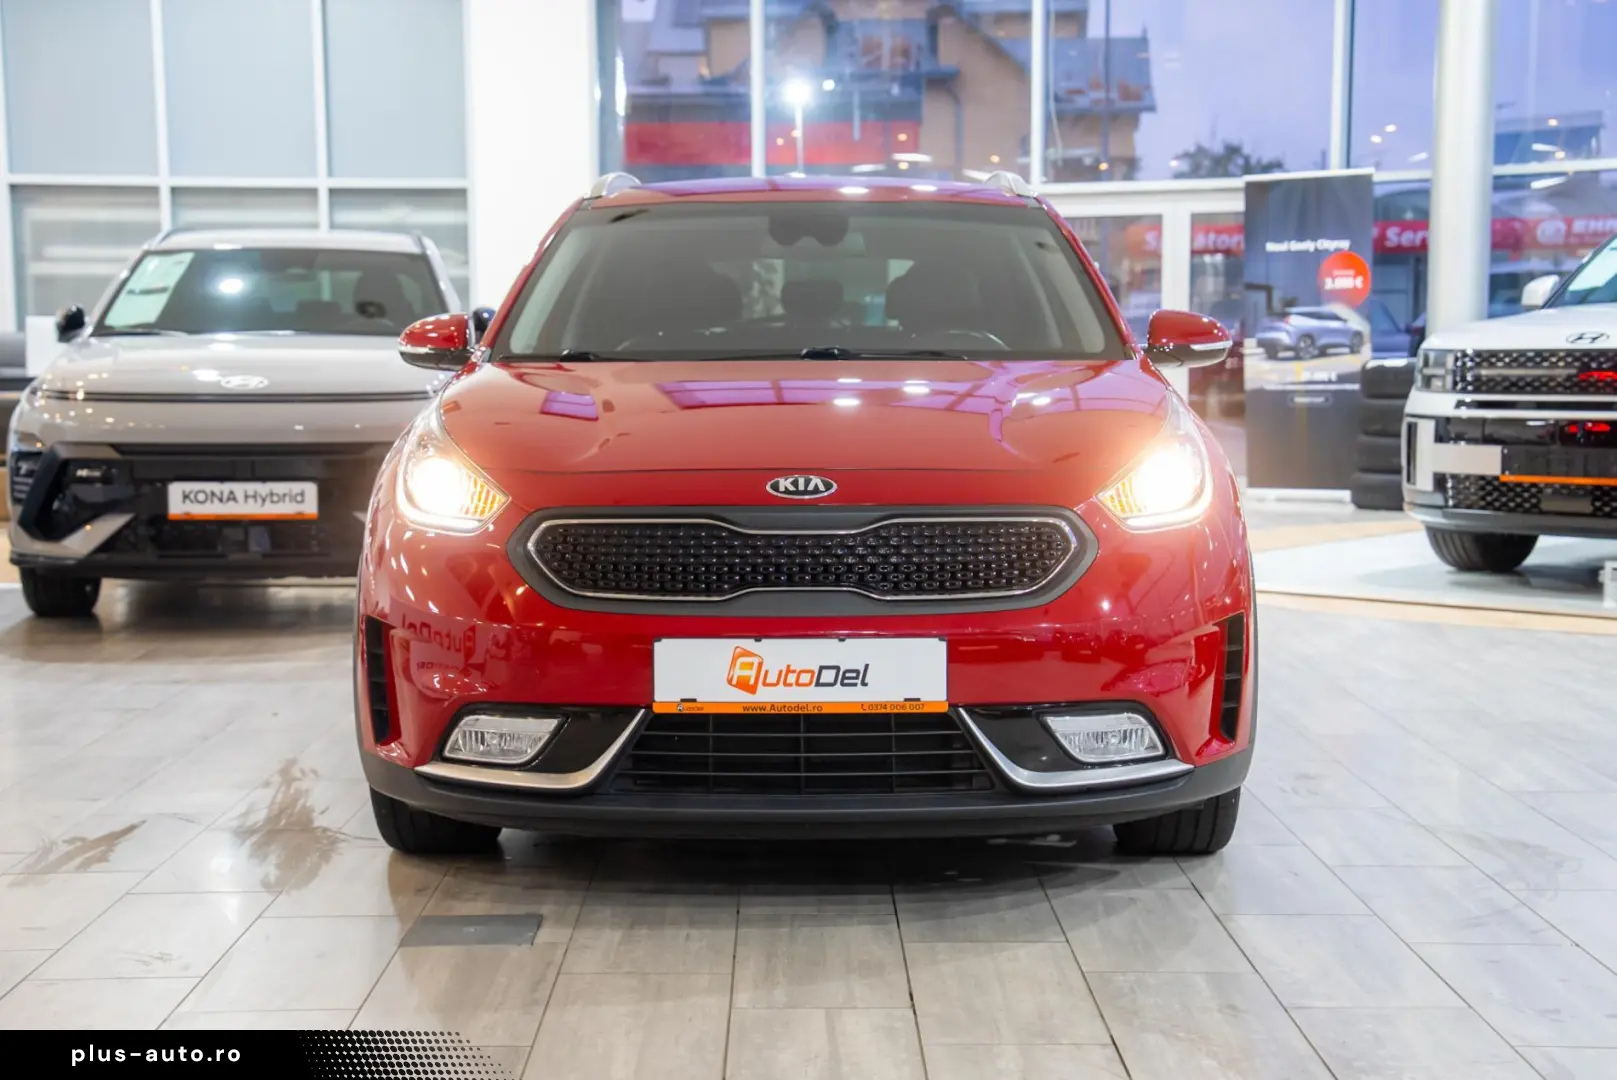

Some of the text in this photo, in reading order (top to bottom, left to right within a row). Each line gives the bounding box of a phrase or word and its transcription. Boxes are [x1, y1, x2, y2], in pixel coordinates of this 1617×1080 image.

[778, 477, 826, 492] KIA
[182, 488, 306, 508] KONA Hybrid
[726, 645, 870, 696] AutoDel
[742, 702, 823, 714] www.Autodel.ro
[868, 703, 888, 712] 0374
[909, 703, 925, 712] 007
